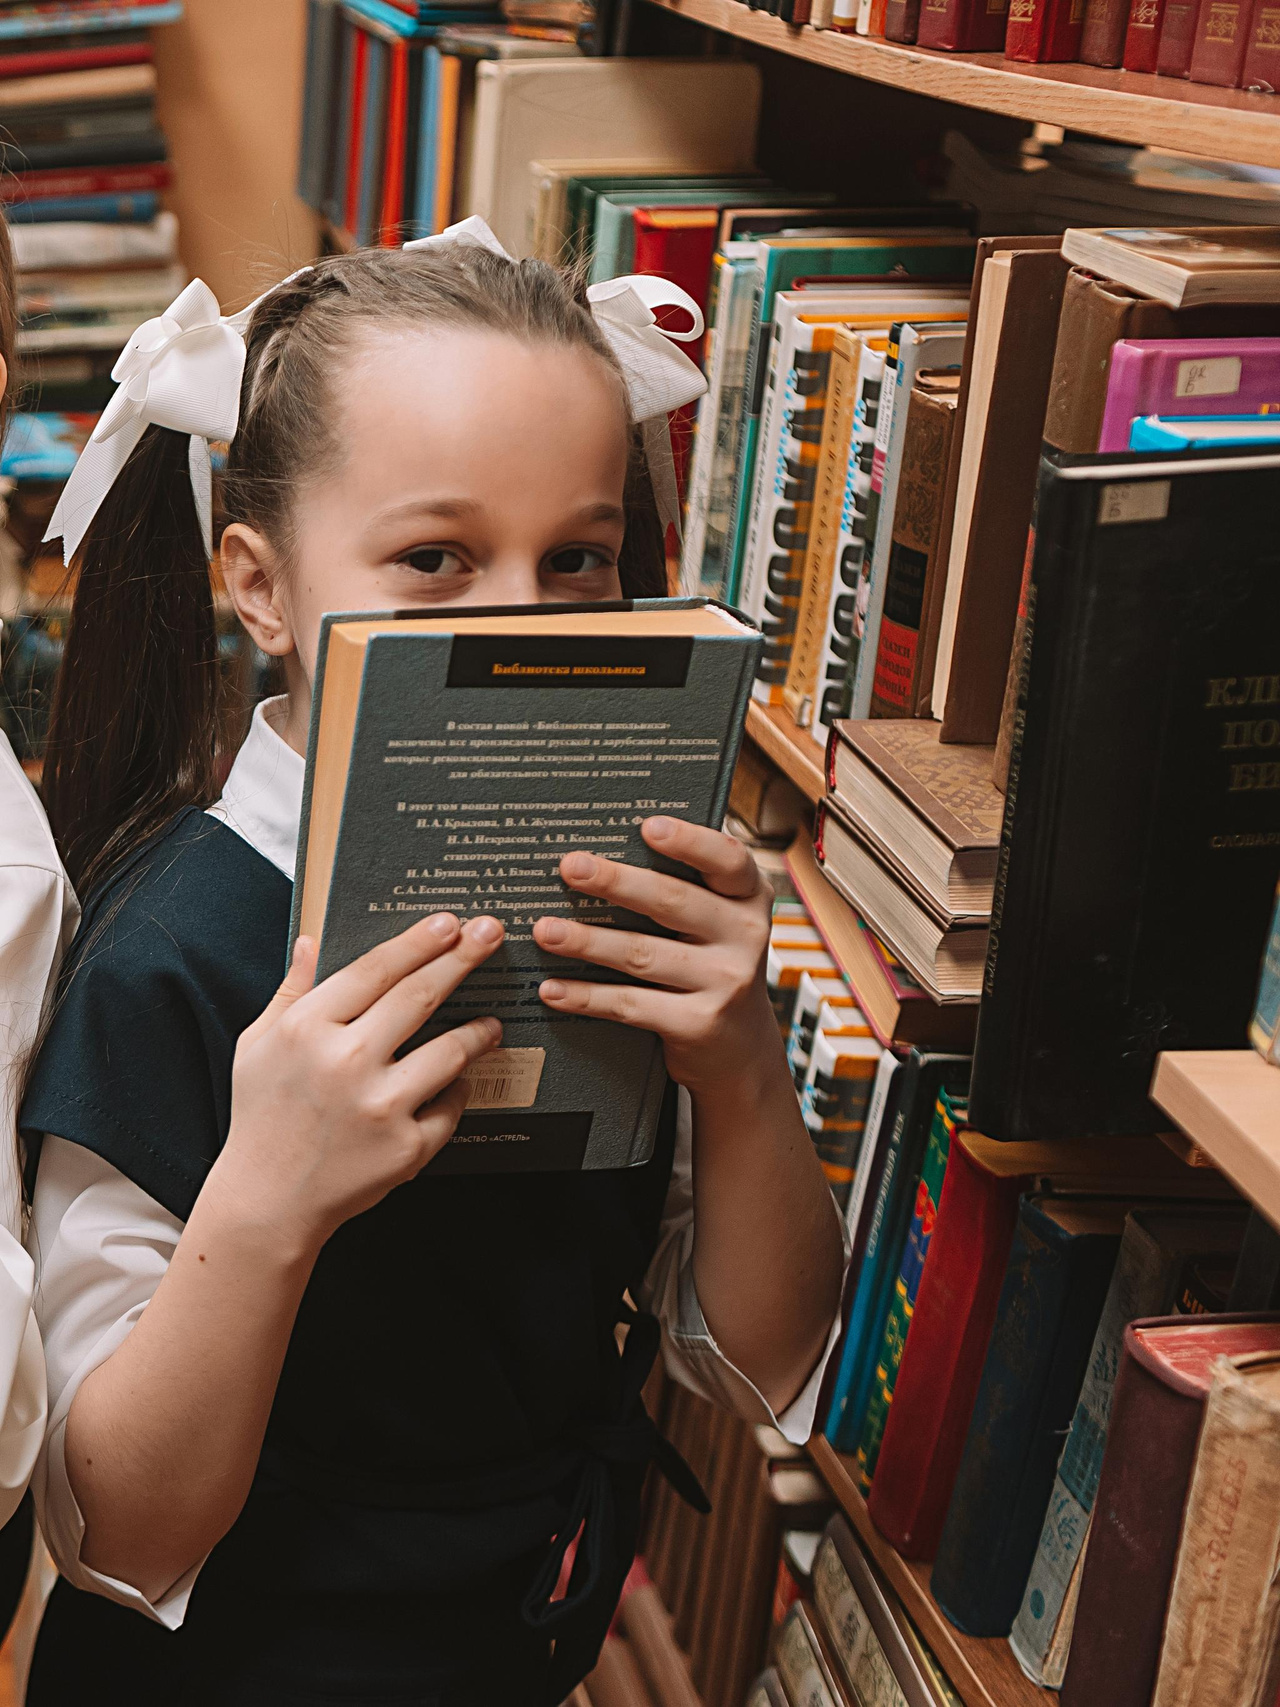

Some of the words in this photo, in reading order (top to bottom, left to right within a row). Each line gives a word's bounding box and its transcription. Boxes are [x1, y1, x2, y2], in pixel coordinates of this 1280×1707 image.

[492, 663, 570, 675] Библиотека
[572, 666, 646, 675] школьника
[447, 721, 456, 730] В
[458, 722, 493, 730] состав
[495, 721, 530, 730] новой
[1221, 718, 1280, 750] ПО
[388, 739, 446, 747] включены
[470, 739, 546, 748] произведения
[549, 738, 591, 748] русской
[603, 737, 666, 748] зарубежной
[384, 756, 431, 765] которые
[432, 755, 520, 764] рекомендованы
[522, 753, 595, 764] действующей
[598, 753, 652, 762] школьной
[655, 752, 720, 763] программой
[448, 771, 468, 779] для
[470, 769, 548, 778] обязательного
[601, 770, 651, 779] изучения
[397, 802, 406, 811] В
[409, 803, 434, 811] этот
[502, 802, 590, 811] стихотворения
[592, 802, 632, 810] поэтов
[634, 799, 658, 809] XIX
[531, 817, 603, 828] Жуковского,
[474, 834, 539, 845] Некрасова,
[444, 853, 530, 862] стихотворения
[533, 852, 566, 860] поэто
[499, 884, 563, 893] Ахматовой,
[396, 902, 467, 912] Пастернака,
[495, 900, 574, 911] Твардовского,
[449, 1135, 487, 1143] ТЕЛЬСТВО
[489, 1134, 531, 1142] «АСТРЕЛЬ»
